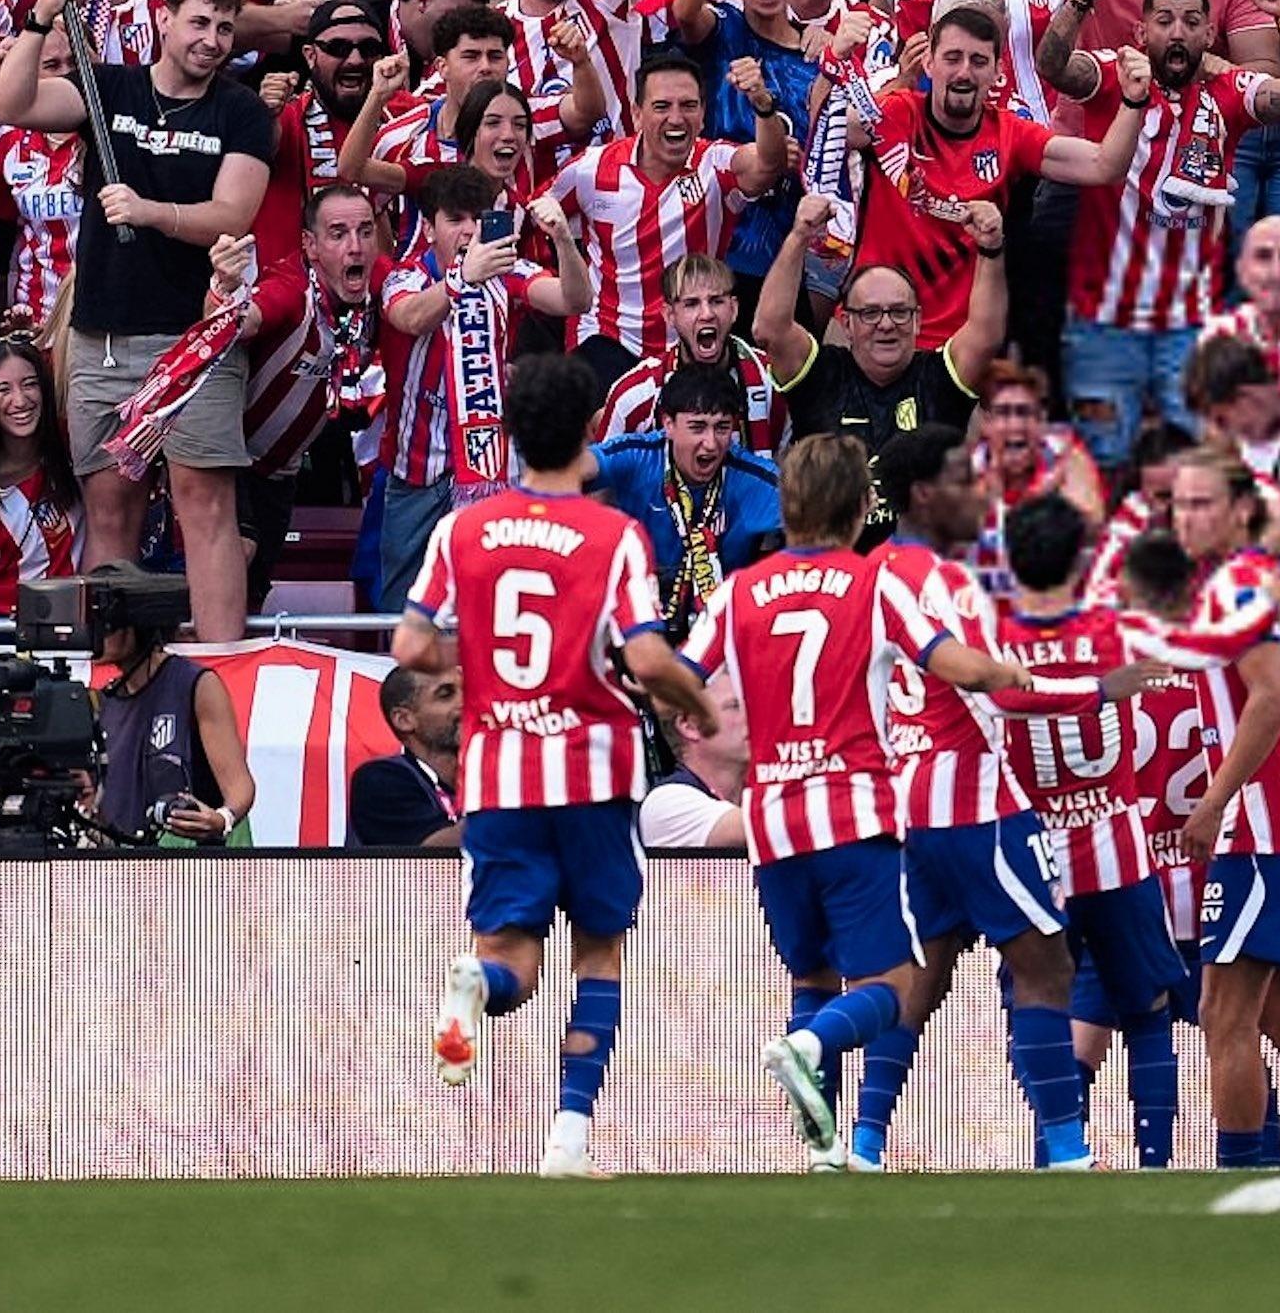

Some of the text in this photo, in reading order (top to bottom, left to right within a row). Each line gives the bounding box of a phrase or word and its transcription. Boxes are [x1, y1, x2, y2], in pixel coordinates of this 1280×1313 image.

[480, 518, 586, 557] JOHNNY
[750, 567, 855, 608] KANGIN
[492, 568, 557, 690] 5
[770, 610, 830, 727] 7
[1027, 698, 1122, 789] 10
[1040, 796, 1128, 830] WANDA
[1047, 786, 1110, 814] VISIT
